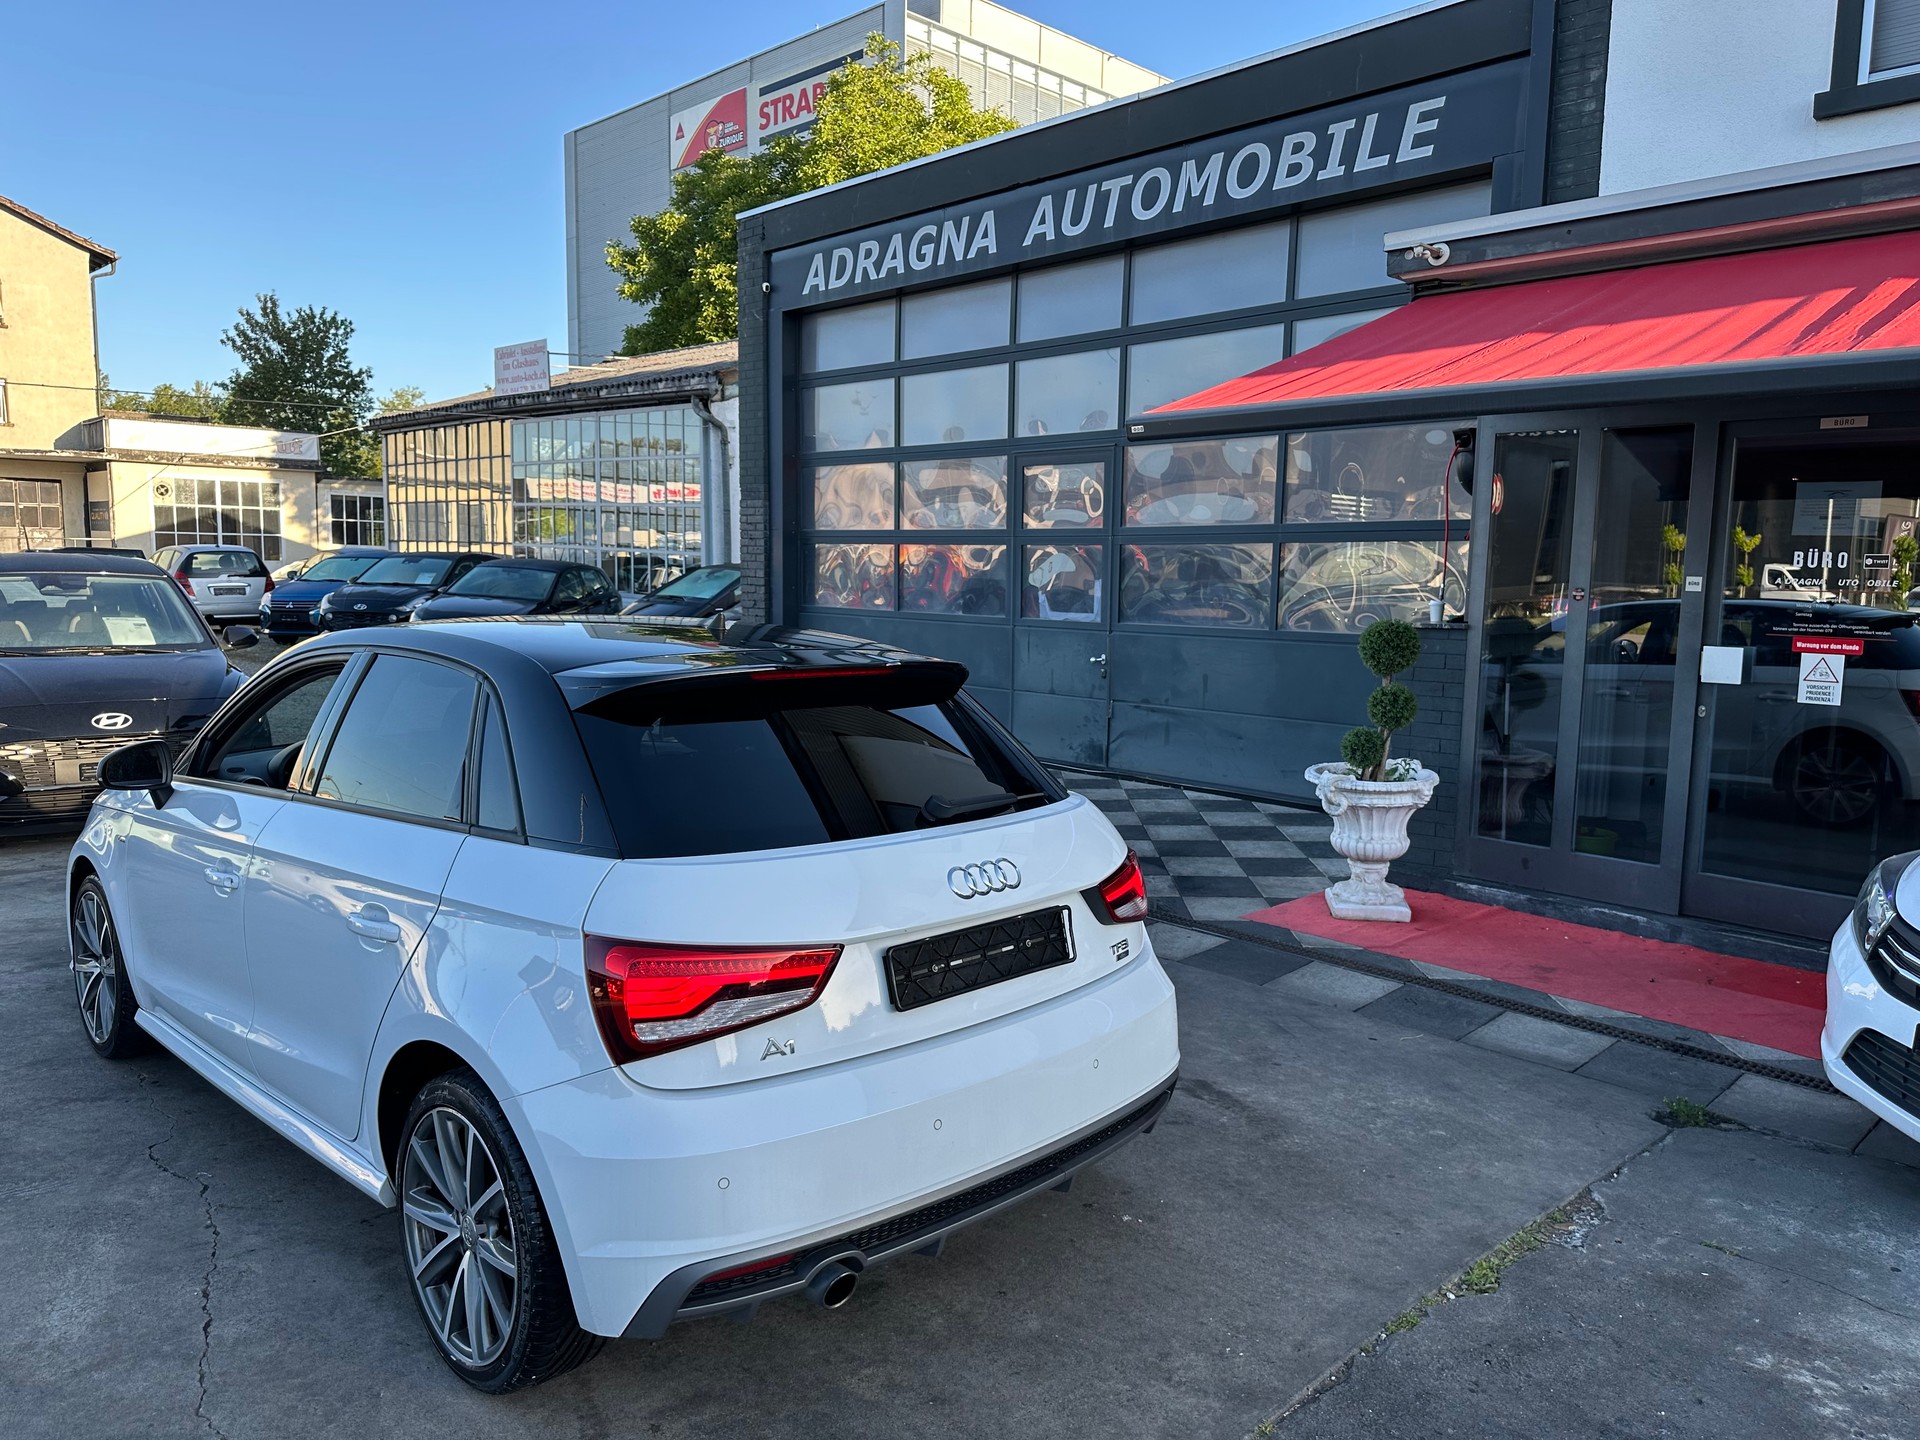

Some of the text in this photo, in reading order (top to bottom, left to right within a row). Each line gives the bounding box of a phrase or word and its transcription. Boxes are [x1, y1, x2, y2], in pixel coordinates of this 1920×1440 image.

[719, 131, 744, 147] ZURIQUE
[802, 96, 1447, 295] ADRAGNA AUTOMOBILE
[1833, 418, 1855, 426] BÜRO
[1793, 548, 1848, 568] BÜRO
[1796, 641, 1820, 650] Warnung
[1842, 643, 1860, 651] Hunde
[1805, 695, 1831, 703] PRUDENZA
[760, 1036, 796, 1062] A1
